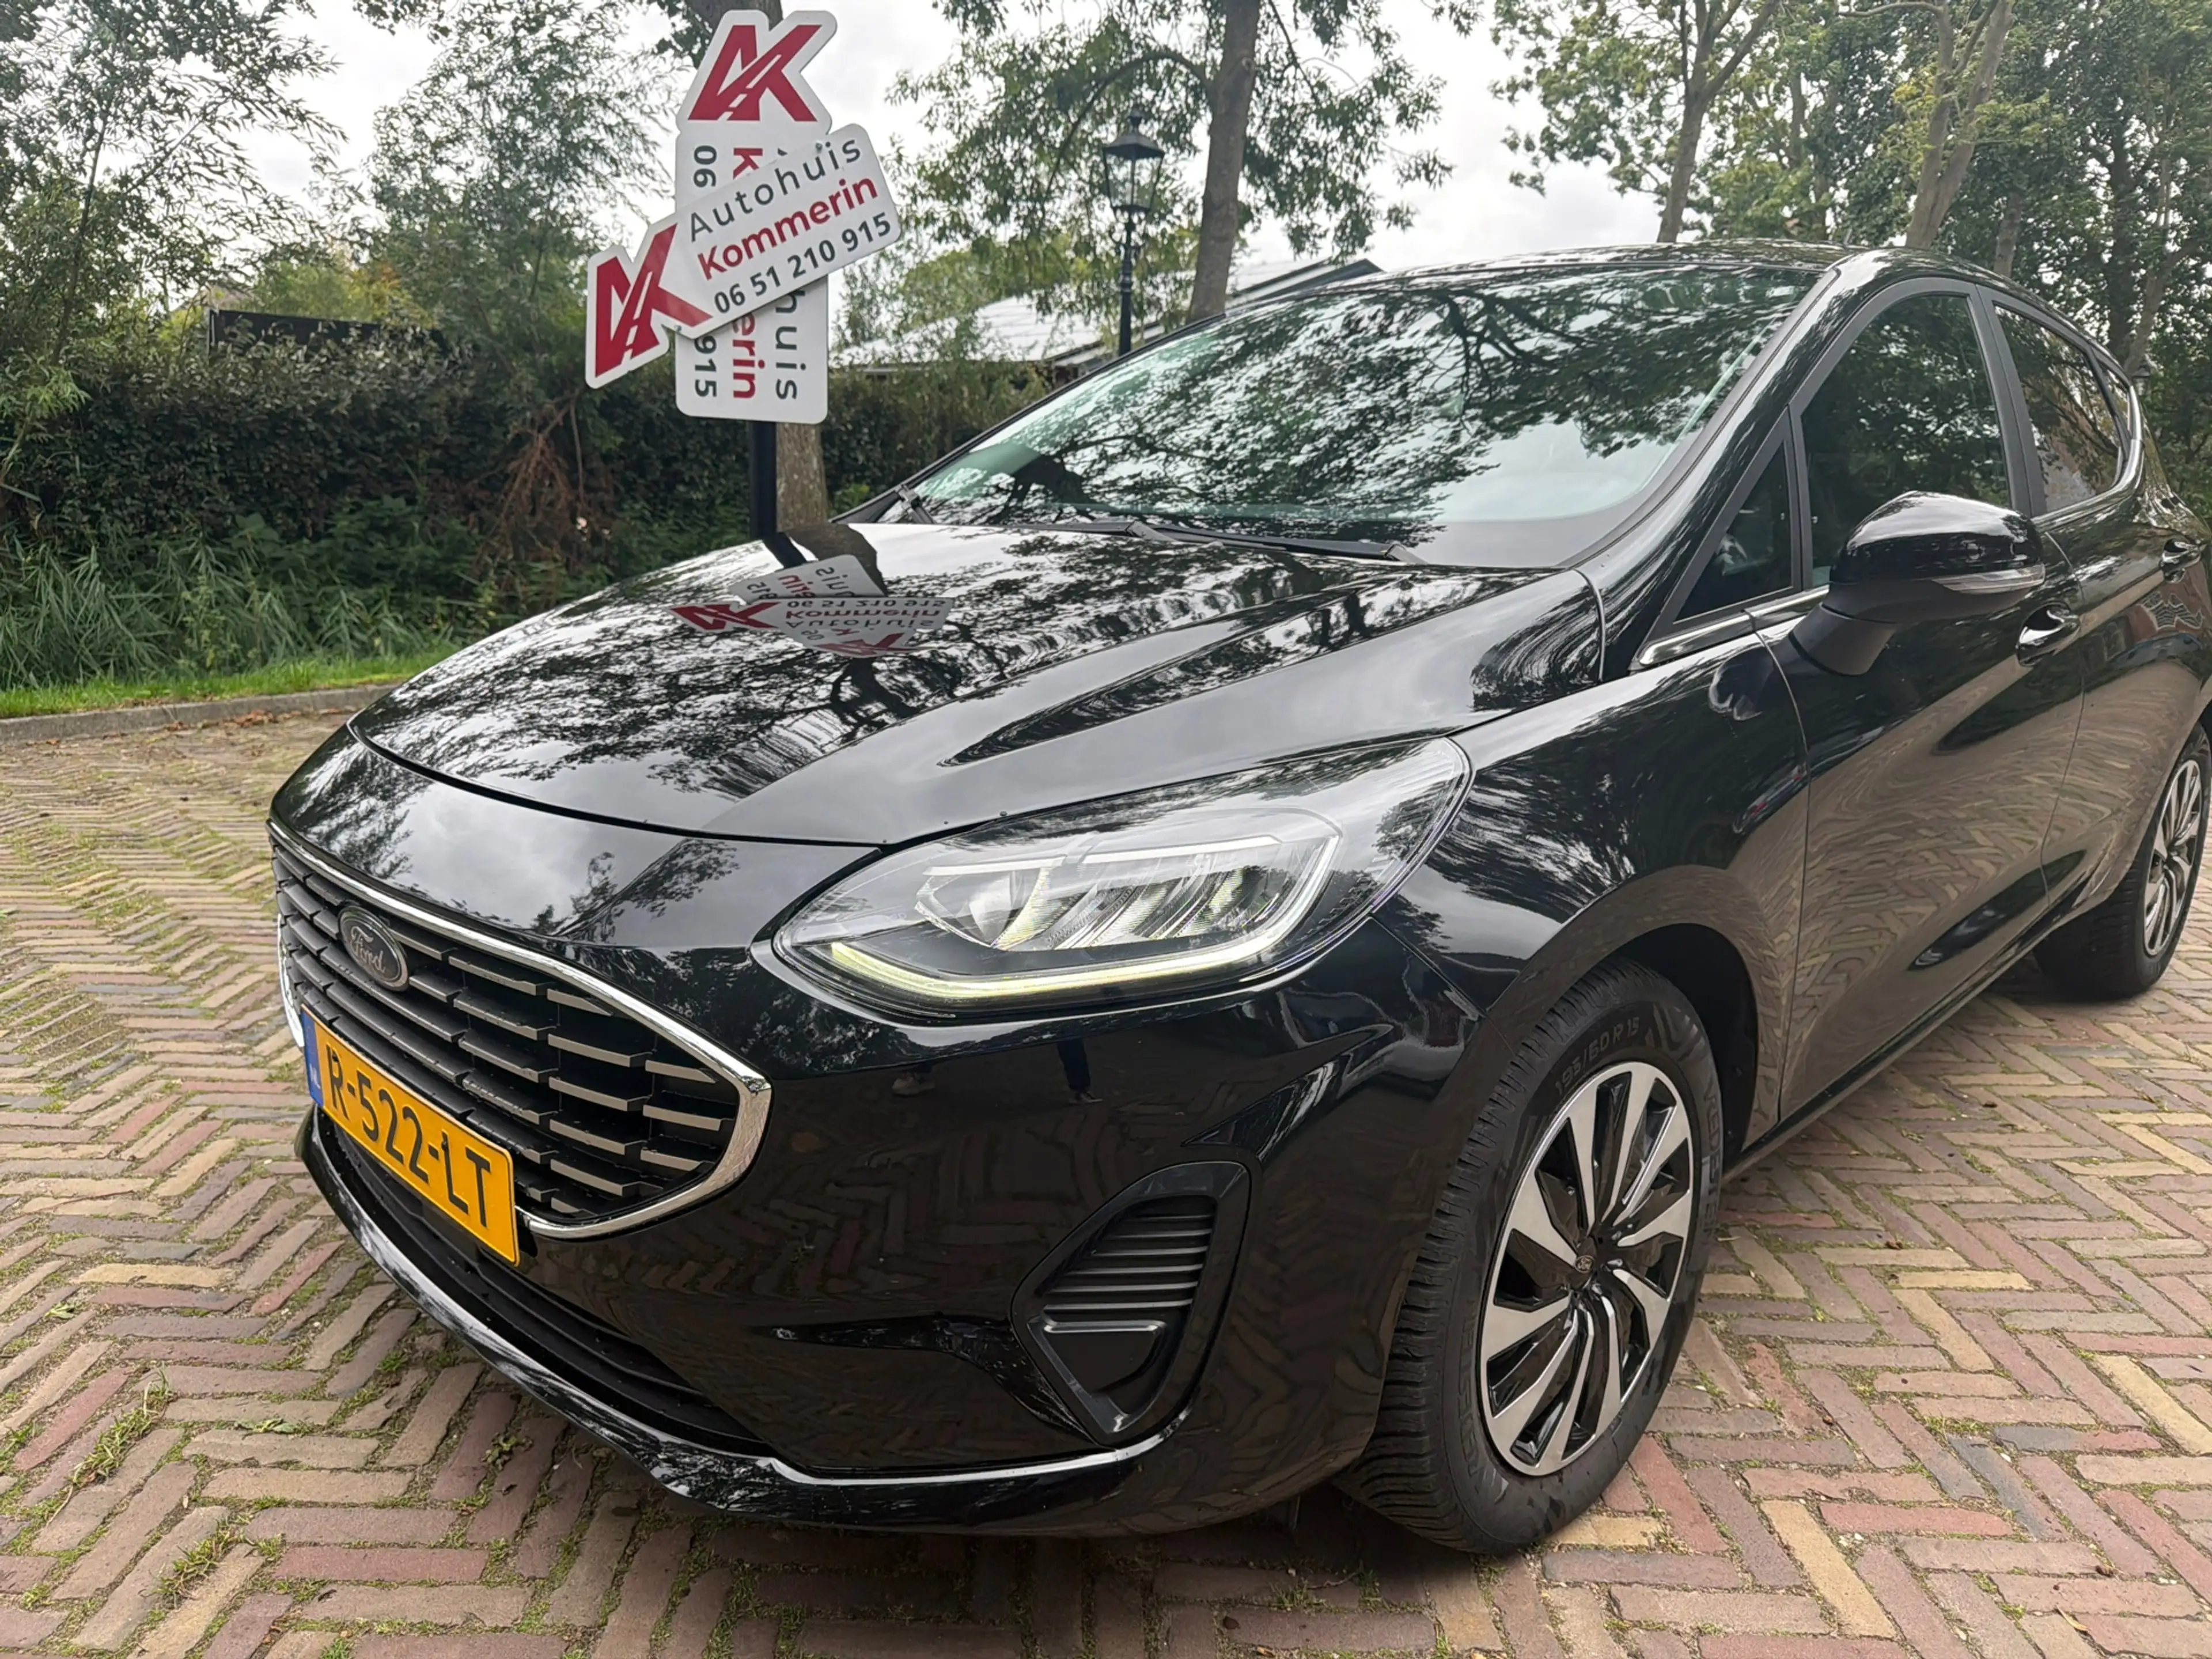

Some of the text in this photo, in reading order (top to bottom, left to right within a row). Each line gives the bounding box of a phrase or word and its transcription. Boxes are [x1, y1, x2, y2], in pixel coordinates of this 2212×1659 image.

[691, 139, 861, 243] Autohuis
[698, 178, 878, 281] Kommerin
[693, 145, 717, 397] 06 915
[714, 212, 891, 313] 06 51 210 915
[350, 925, 386, 974] Ford
[326, 1043, 491, 1228] R-522-LT
